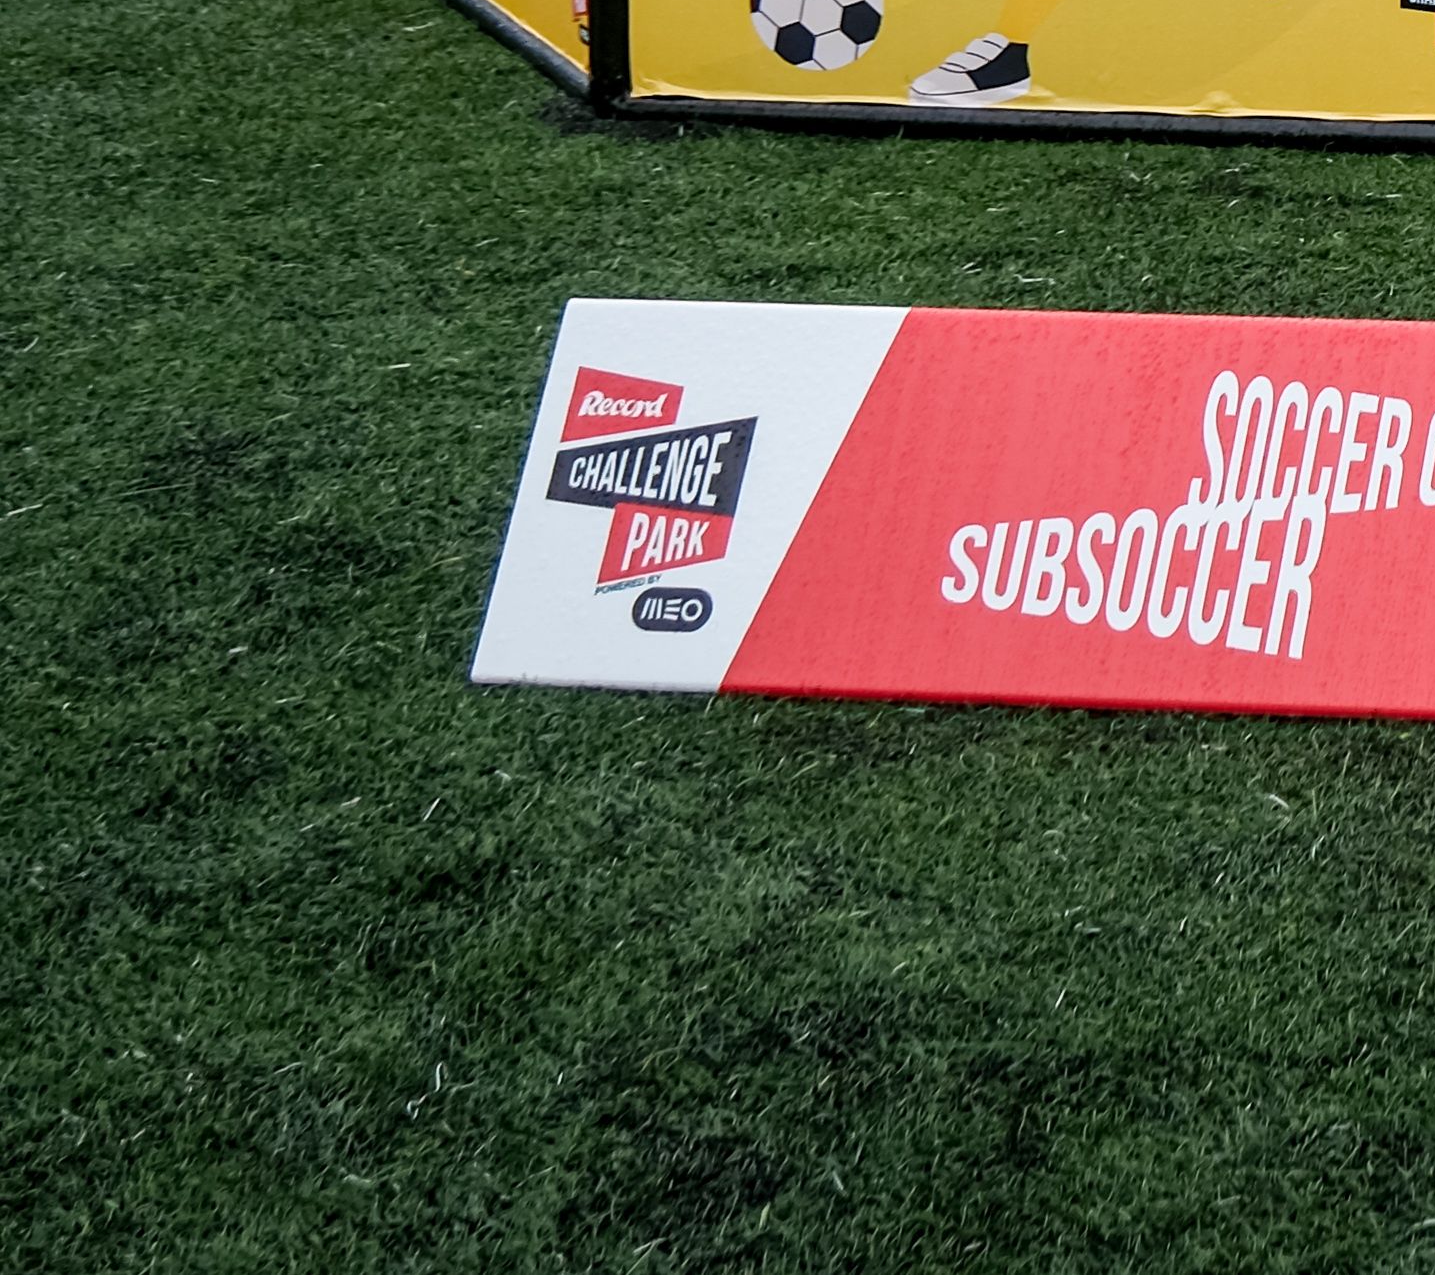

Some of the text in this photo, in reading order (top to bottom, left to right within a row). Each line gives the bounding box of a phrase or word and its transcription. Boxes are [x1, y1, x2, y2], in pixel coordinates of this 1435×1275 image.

[577, 390, 669, 418] Record
[568, 430, 732, 507] CHALLENGE
[1188, 370, 1414, 529] SOCCER
[620, 512, 710, 572] PARK
[594, 574, 662, 596] POWERED BY
[941, 496, 1328, 660] SUBSOCCER
[640, 597, 703, 622] MEO
